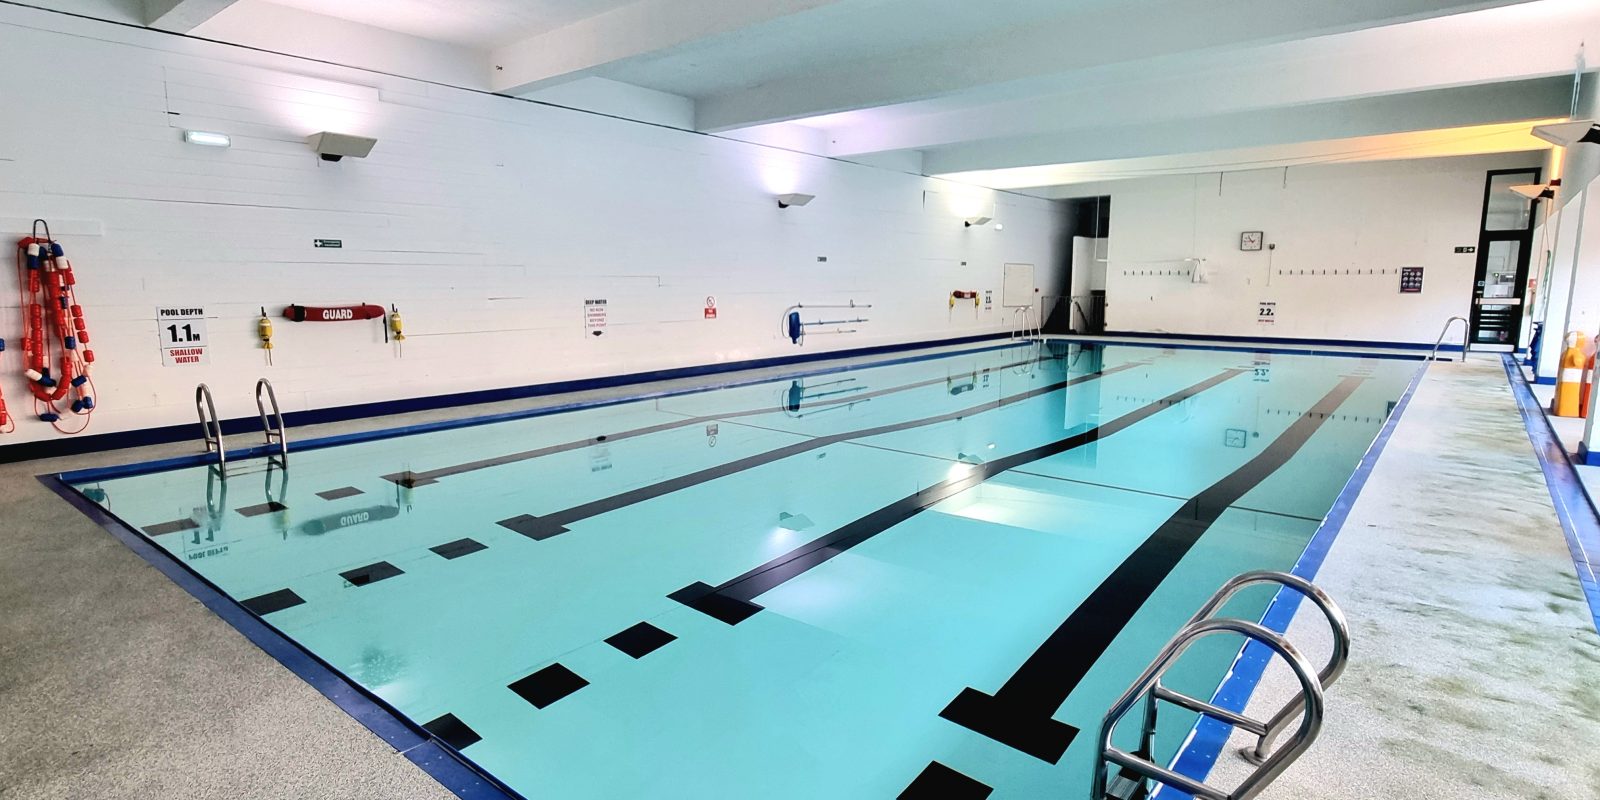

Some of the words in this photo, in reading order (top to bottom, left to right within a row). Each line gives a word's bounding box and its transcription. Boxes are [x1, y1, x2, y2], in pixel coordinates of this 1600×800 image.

[322, 309, 353, 320] GUARD
[170, 348, 203, 357] SHALLOW
[175, 356, 200, 364] WATER
